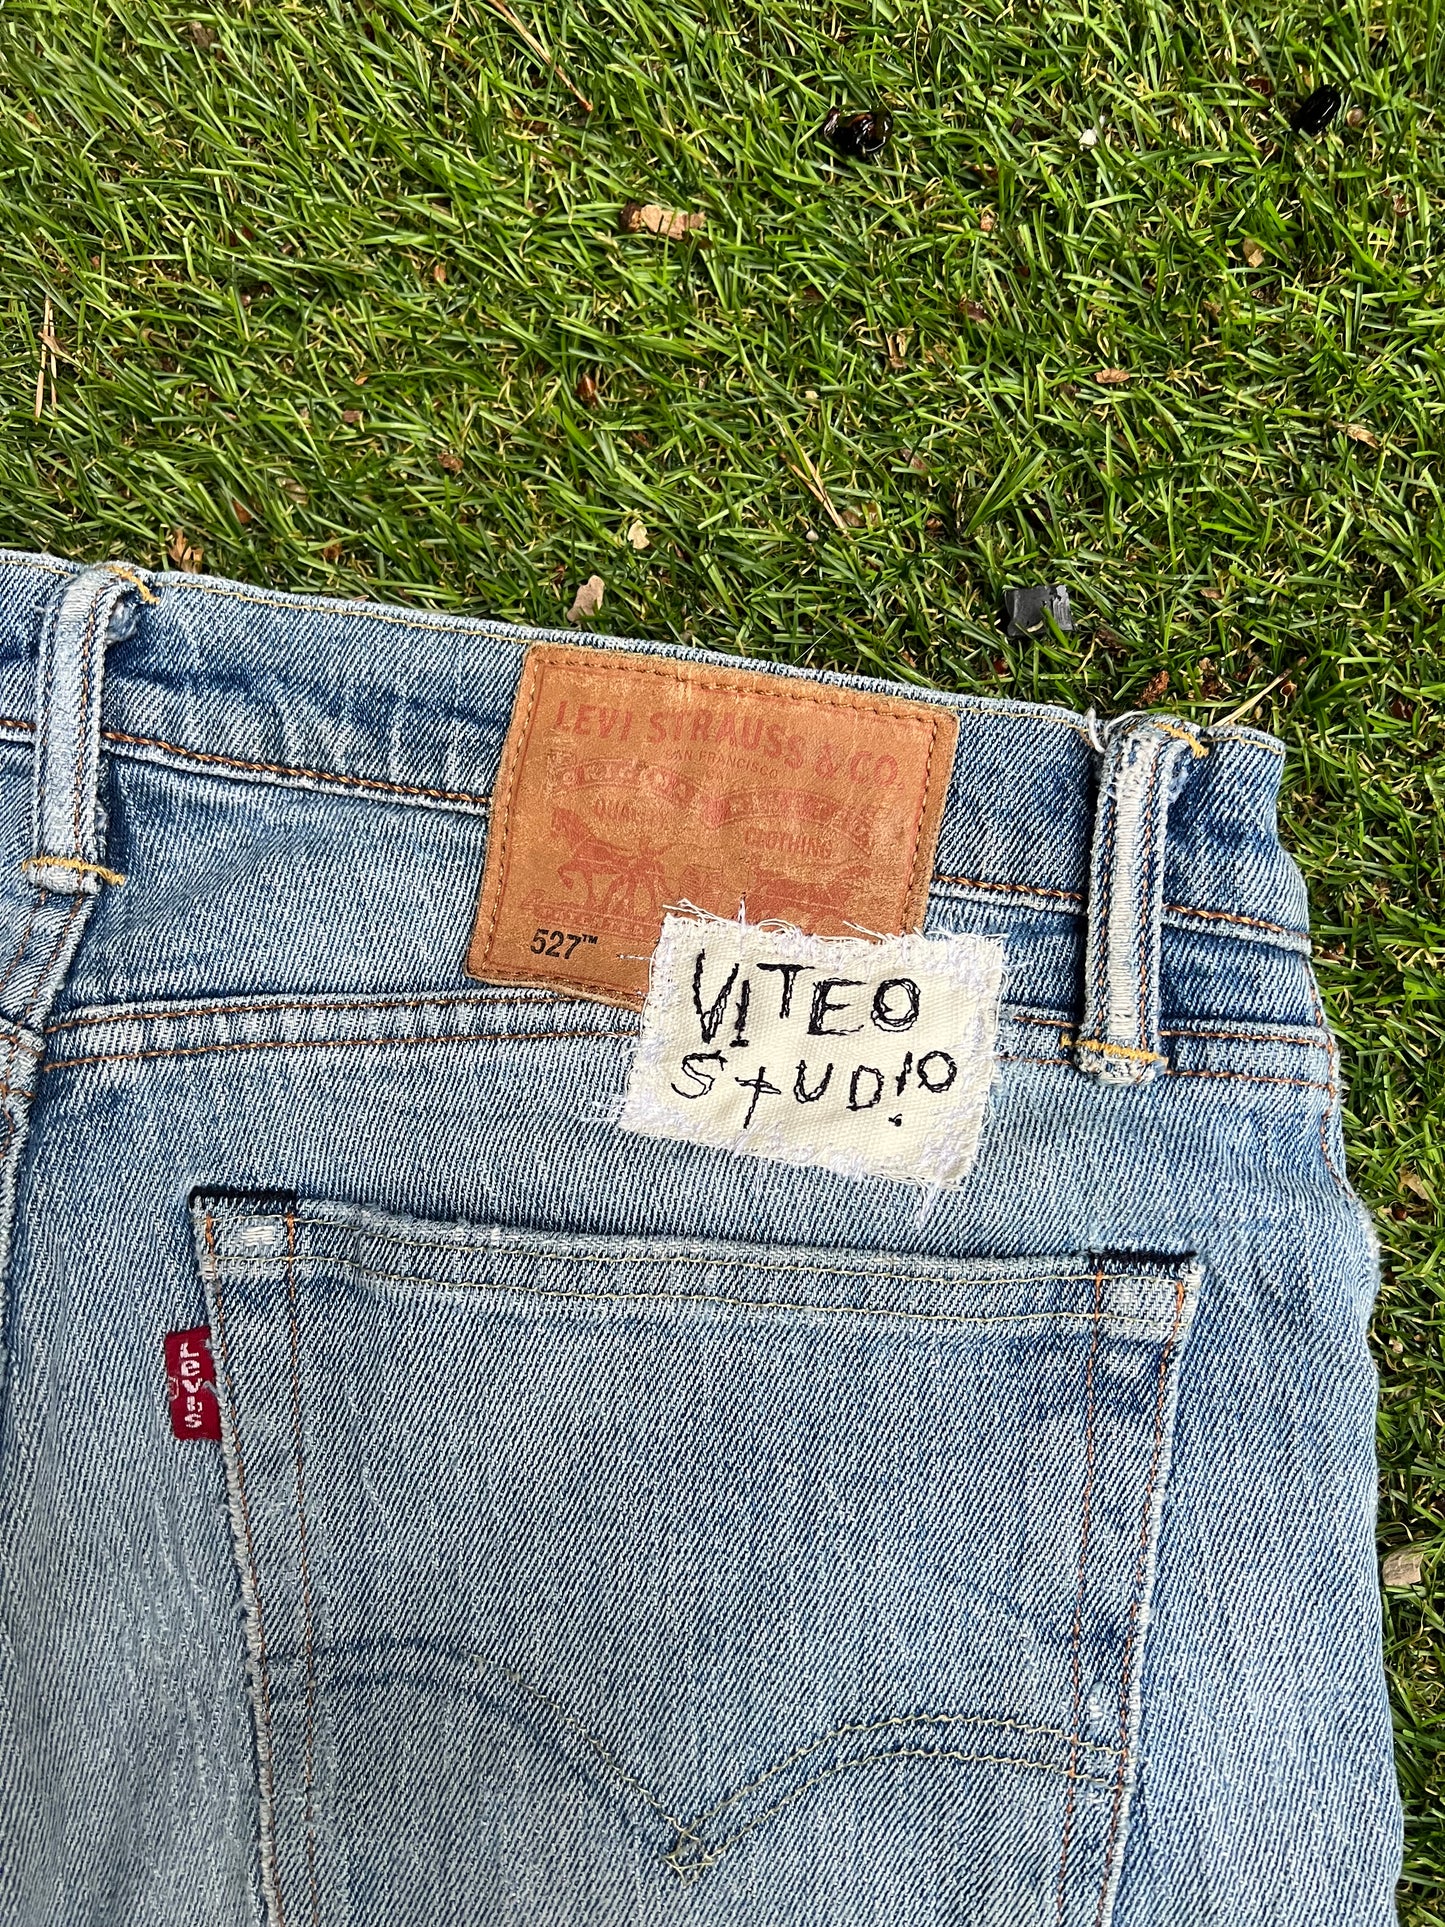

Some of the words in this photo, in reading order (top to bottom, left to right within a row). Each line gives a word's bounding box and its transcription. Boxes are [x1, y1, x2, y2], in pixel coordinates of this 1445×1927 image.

[554, 700, 633, 742] LEVI
[647, 707, 804, 770] STRAUSS
[814, 743, 841, 778] &
[665, 749, 694, 762] SAN
[699, 749, 780, 780] FRANCISCO
[691, 948, 921, 1048] VITEO
